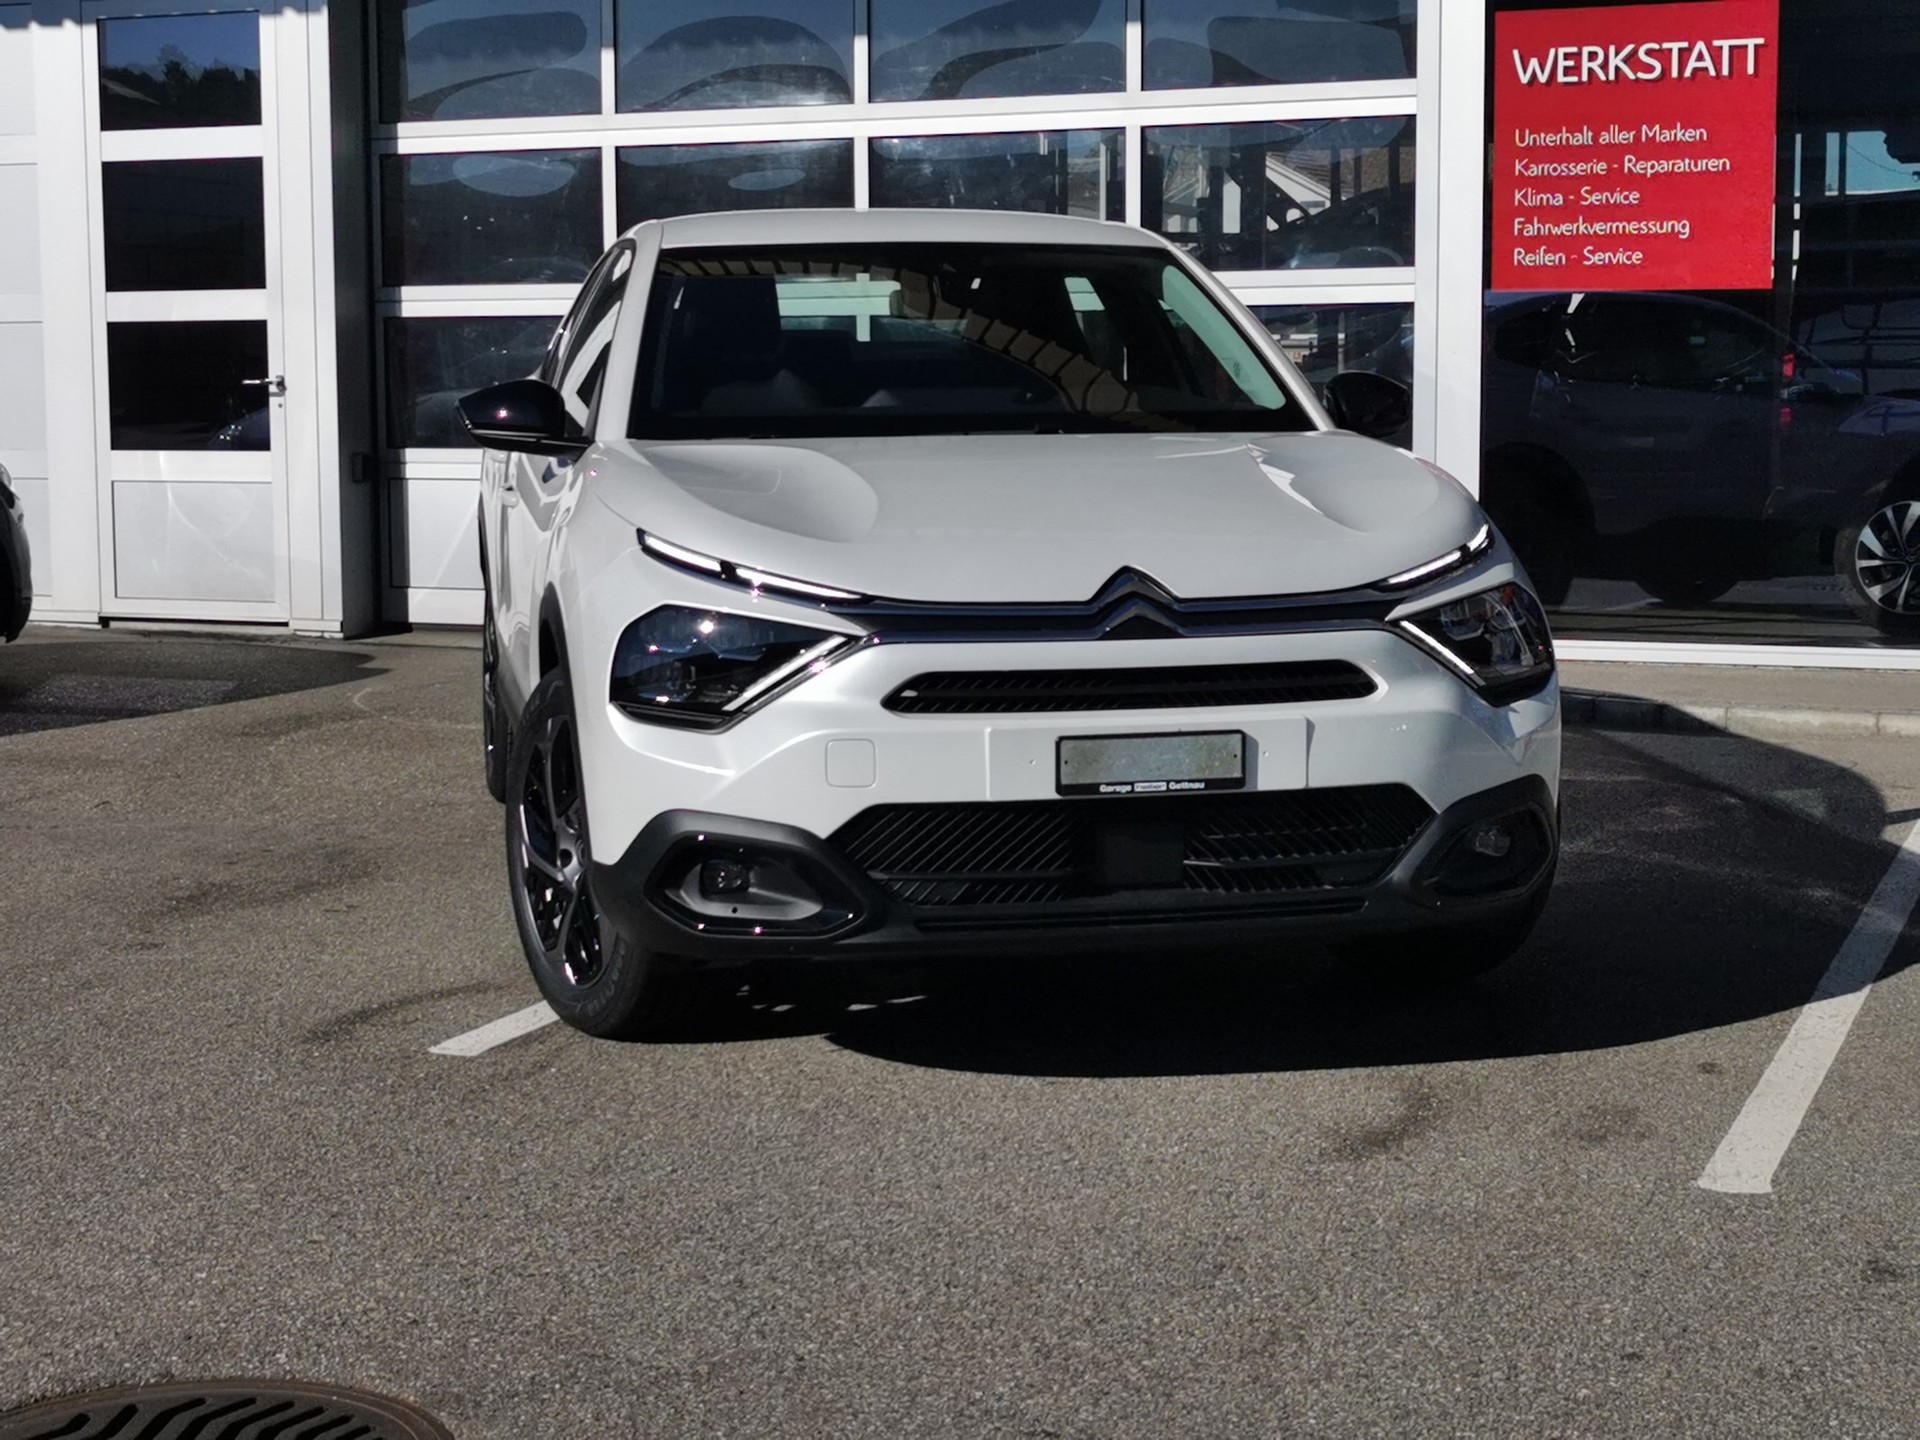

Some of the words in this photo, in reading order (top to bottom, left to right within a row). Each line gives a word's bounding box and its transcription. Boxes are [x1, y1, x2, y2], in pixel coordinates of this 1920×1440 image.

[1512, 37, 1765, 84] WERKSTATT
[1515, 126, 1594, 148] Unterhalt
[1599, 125, 1636, 145] aller
[1641, 122, 1708, 143] Marken
[1514, 158, 1607, 177] Karrosserie
[1624, 154, 1730, 178] Reparaturen
[1514, 188, 1563, 207] Klima
[1580, 186, 1640, 205] Service
[1513, 217, 1690, 238] Fahrwerkvermessung
[1513, 247, 1566, 266] Reifen
[1583, 246, 1644, 265] Service
[1099, 784, 1132, 794] Garage
